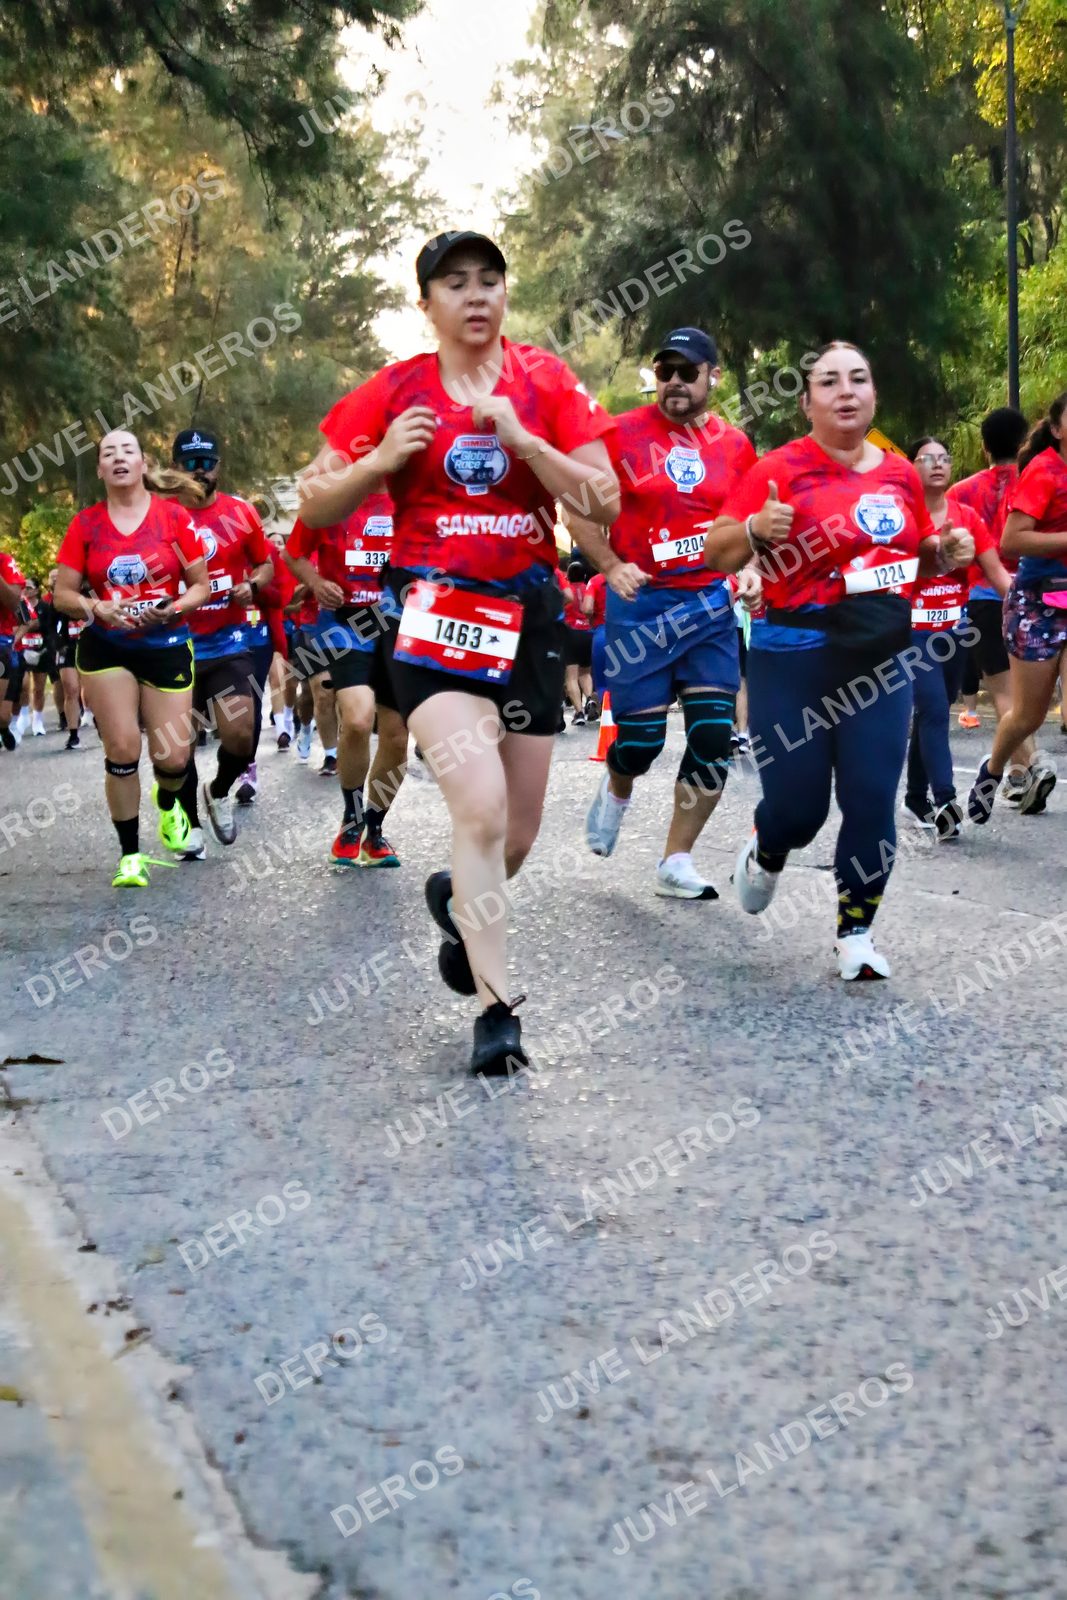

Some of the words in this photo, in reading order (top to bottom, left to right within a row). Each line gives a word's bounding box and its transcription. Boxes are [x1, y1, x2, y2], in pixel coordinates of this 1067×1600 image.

[434, 512, 534, 538] SANTIAGO
[874, 564, 906, 588] 1224
[927, 609, 949, 622] 1220
[435, 618, 483, 650] 1463
